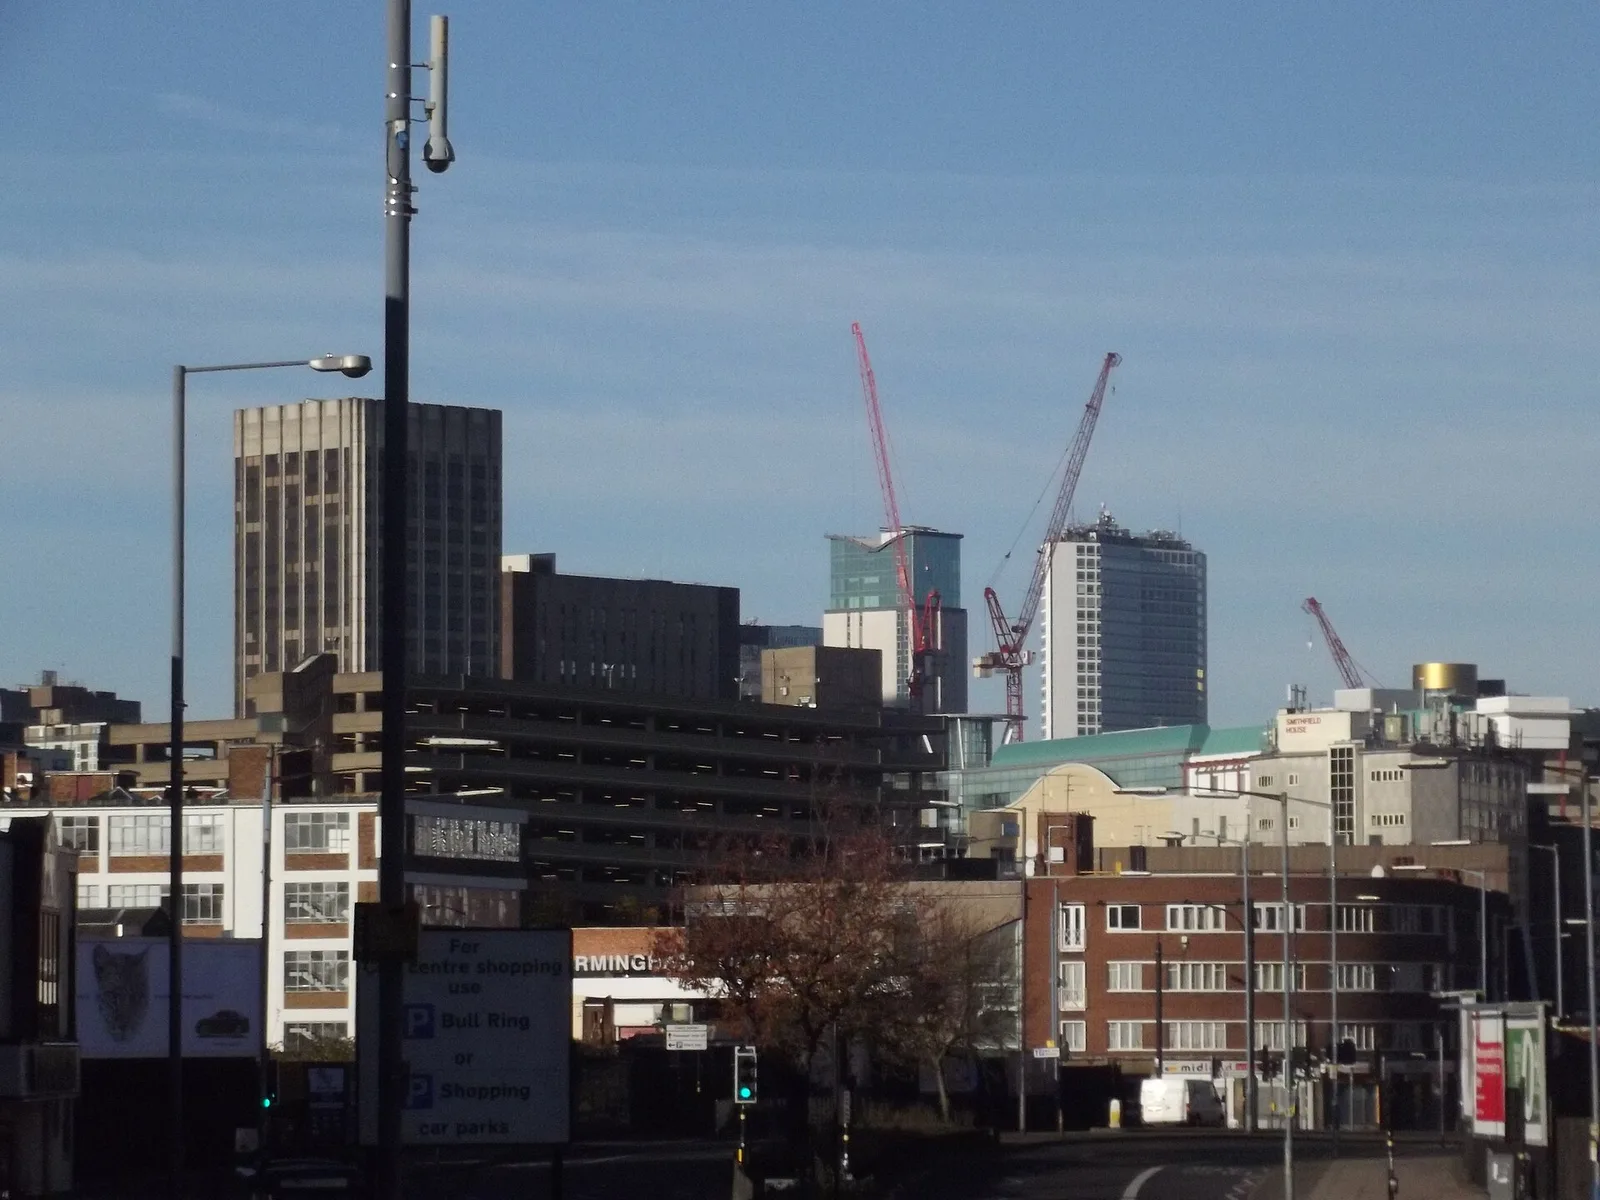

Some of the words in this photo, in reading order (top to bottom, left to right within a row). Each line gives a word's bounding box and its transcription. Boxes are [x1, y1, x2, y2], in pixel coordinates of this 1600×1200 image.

[1286, 717, 1321, 725] SMITHFIELD
[449, 938, 481, 954] For
[477, 958, 562, 976] shopping
[448, 981, 482, 994] use
[441, 1012, 480, 1028] Bull
[488, 1012, 531, 1031] Ring
[454, 1052, 474, 1066] or
[440, 1082, 531, 1101] Shopping
[419, 1122, 448, 1135] car
[456, 1118, 510, 1136] parks
